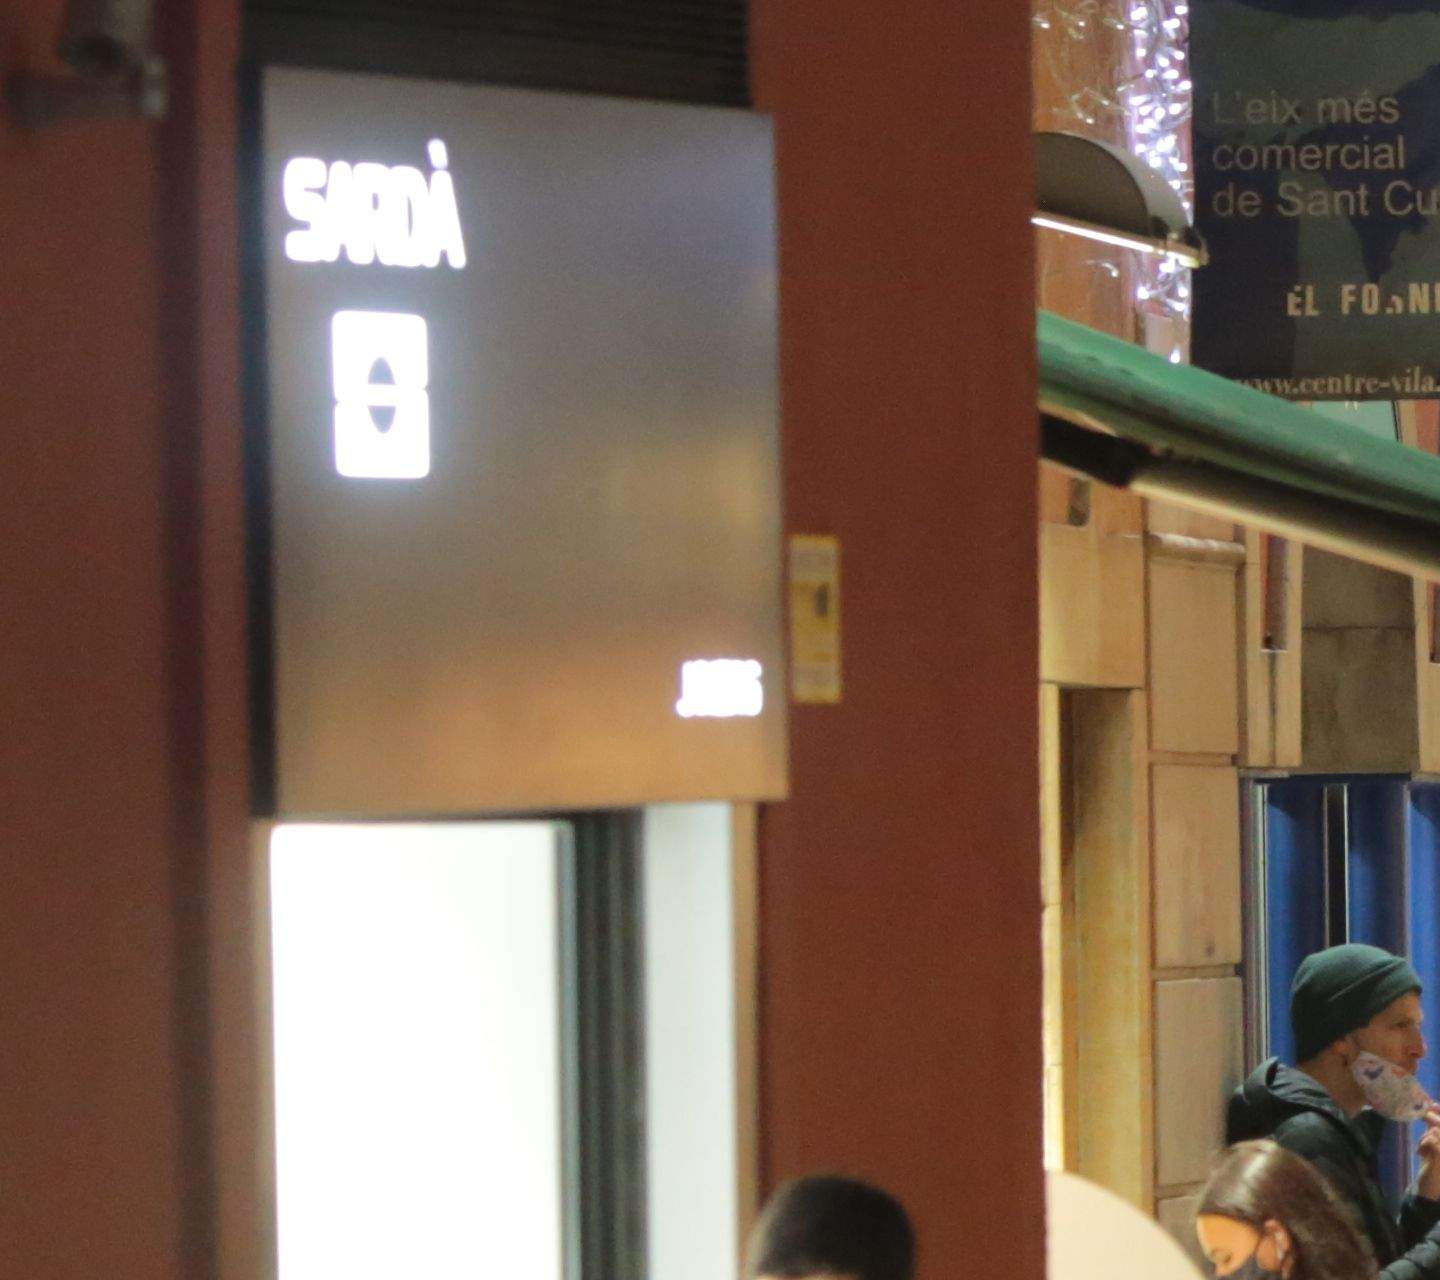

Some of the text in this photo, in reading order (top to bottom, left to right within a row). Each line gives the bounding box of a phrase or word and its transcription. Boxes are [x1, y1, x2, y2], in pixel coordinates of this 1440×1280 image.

[1211, 89, 1401, 124] L'eix més
[1212, 134, 1405, 171] comercial
[283, 138, 467, 269] SARDÀ
[1211, 182, 1262, 218] de
[1276, 181, 1371, 218] Sant
[1286, 285, 1320, 317] EL
